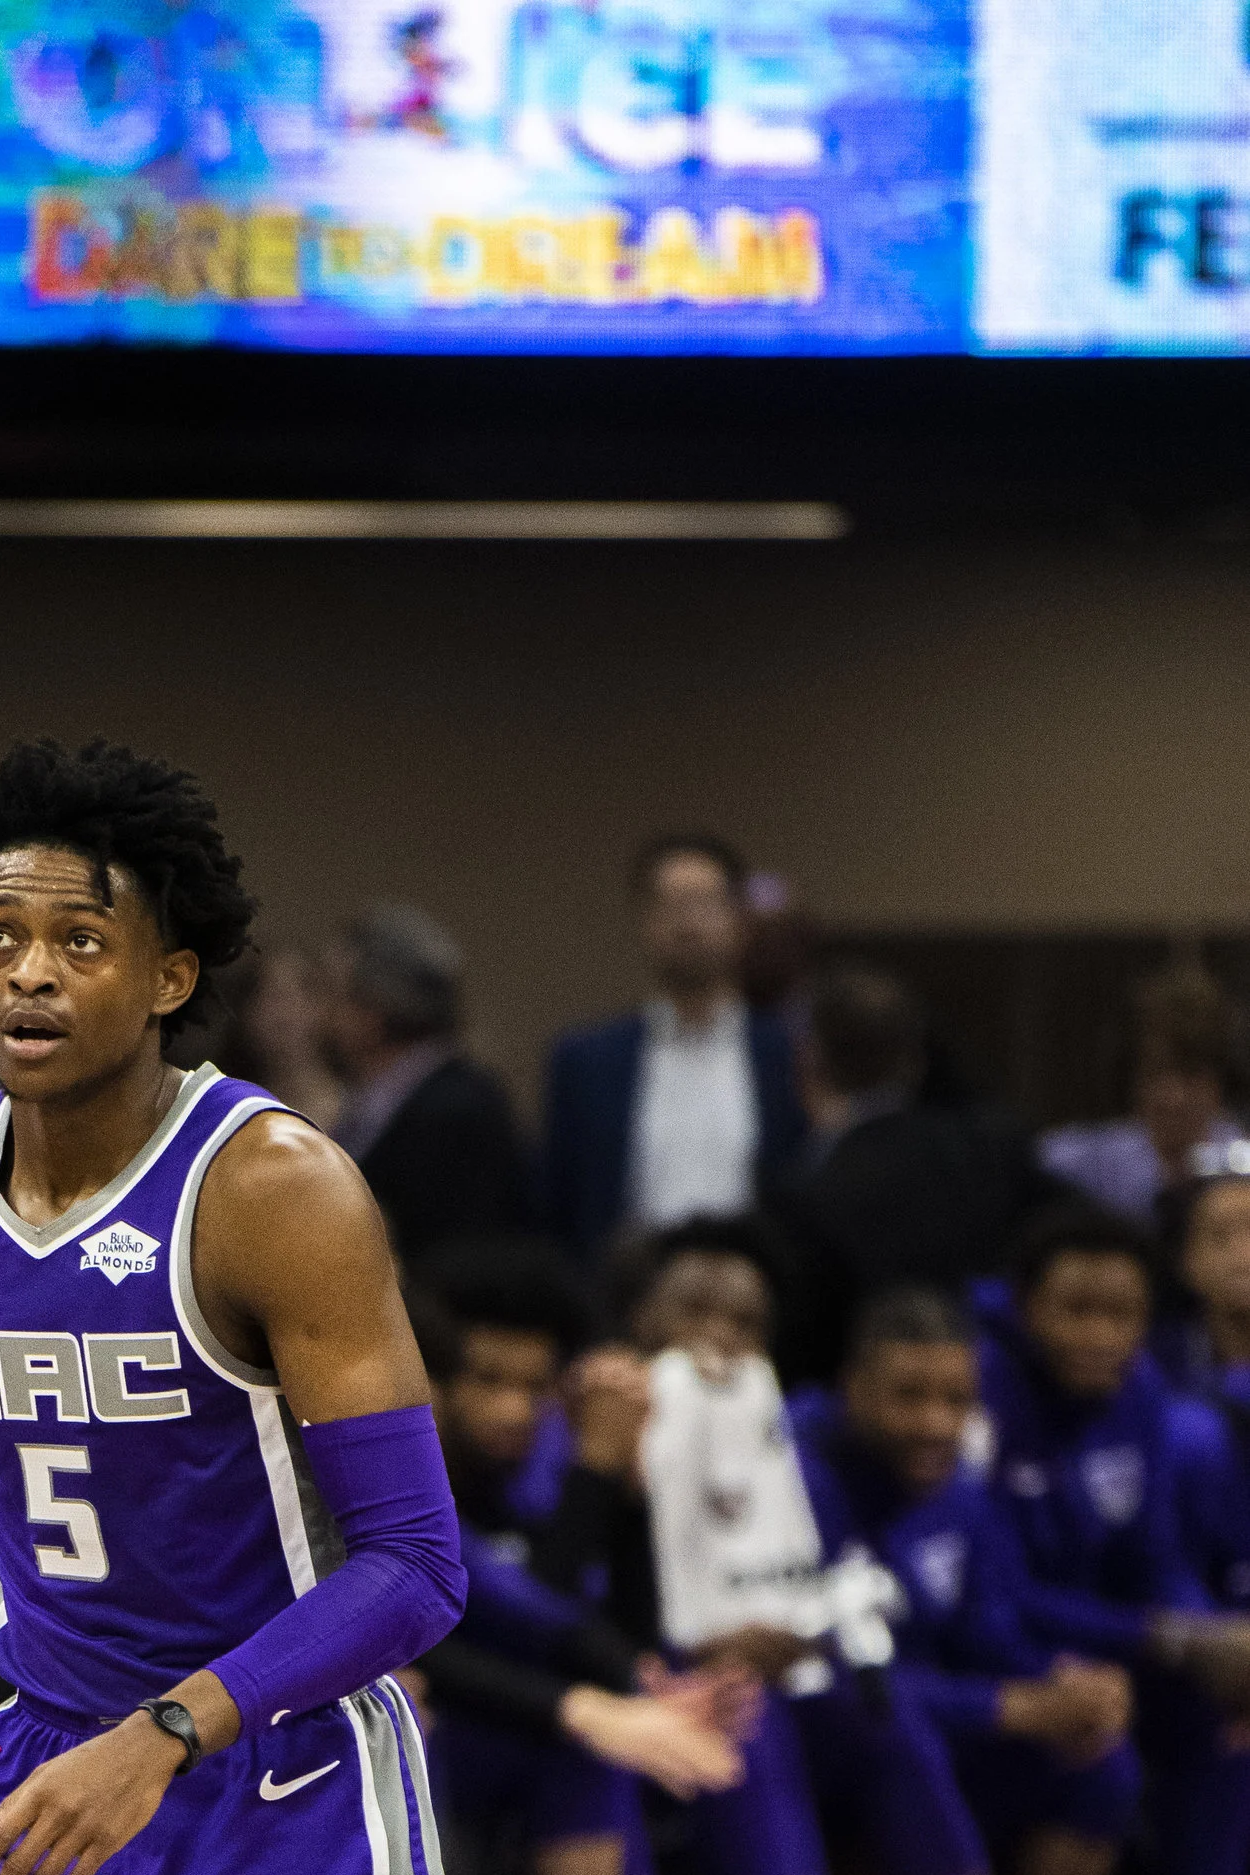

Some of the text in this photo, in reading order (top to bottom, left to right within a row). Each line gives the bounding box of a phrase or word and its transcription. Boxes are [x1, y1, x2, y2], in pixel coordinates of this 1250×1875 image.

[424, 206, 826, 306] DREAM
[110, 1232, 133, 1245] BLUE
[97, 1241, 144, 1254] DIAMOND
[83, 1255, 153, 1272] ALMONDS
[15, 1443, 110, 1583] 5
